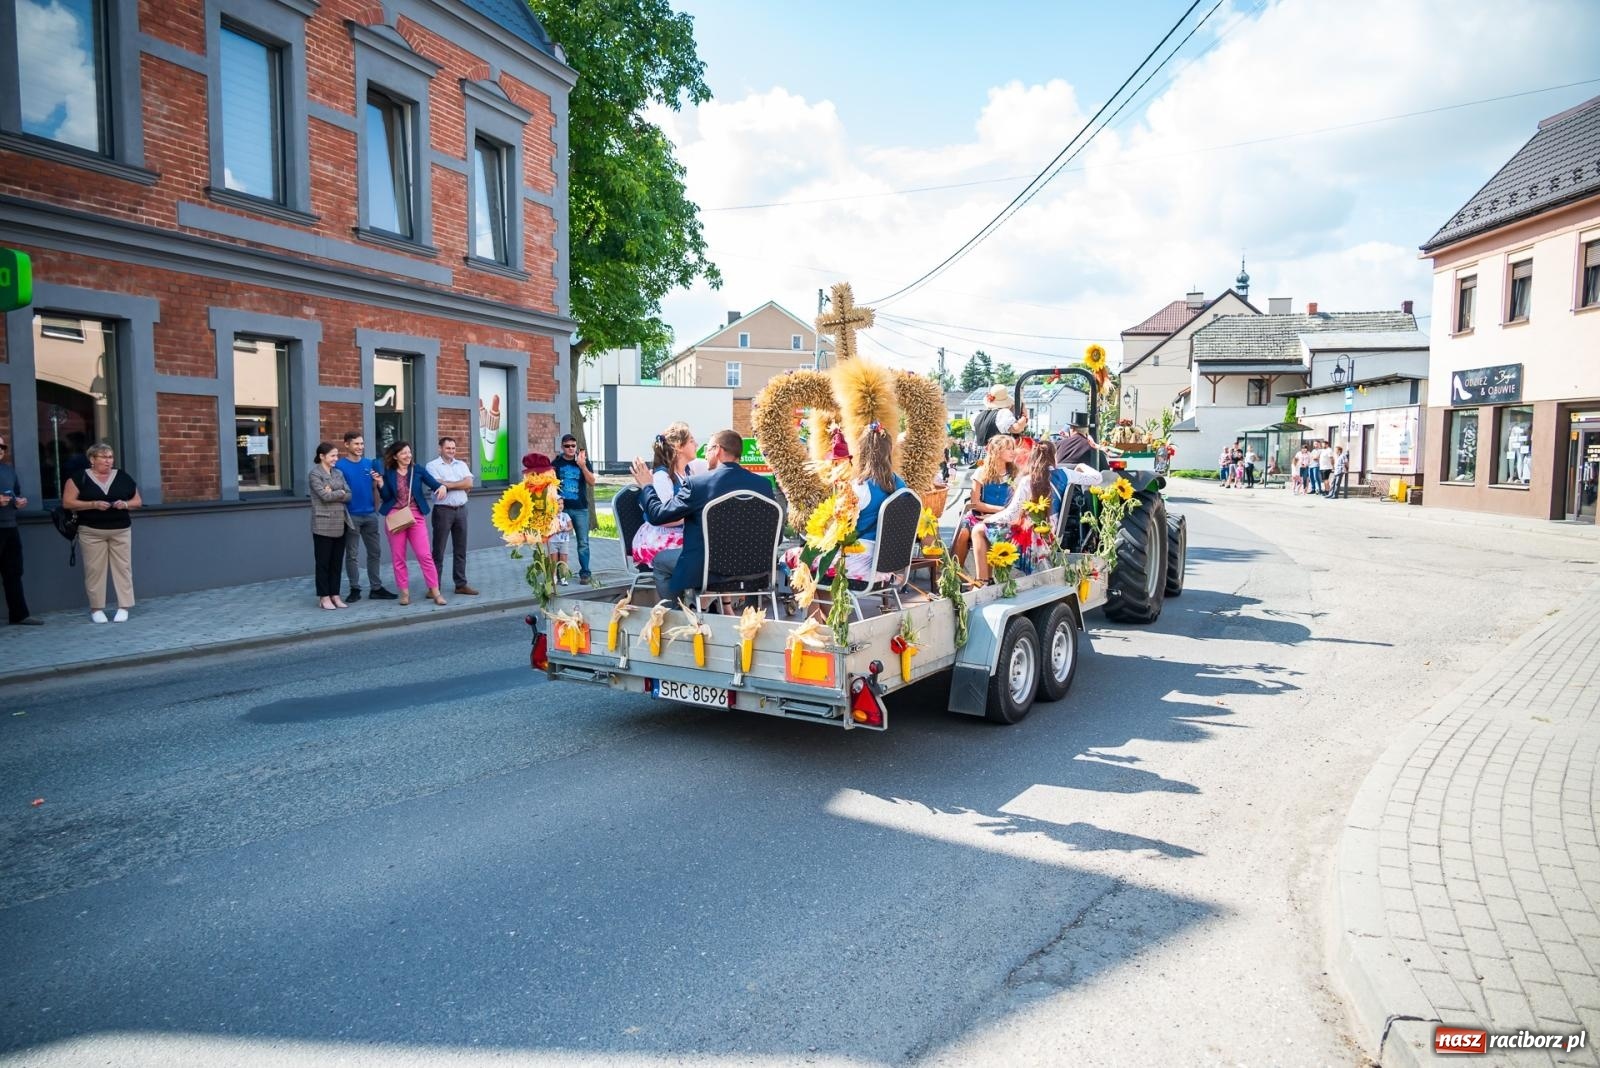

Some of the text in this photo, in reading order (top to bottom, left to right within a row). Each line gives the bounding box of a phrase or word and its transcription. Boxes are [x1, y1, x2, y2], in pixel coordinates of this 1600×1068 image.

[1480, 384, 1516, 396] & OBUWIE
[661, 680, 727, 705] SRC 8G96
